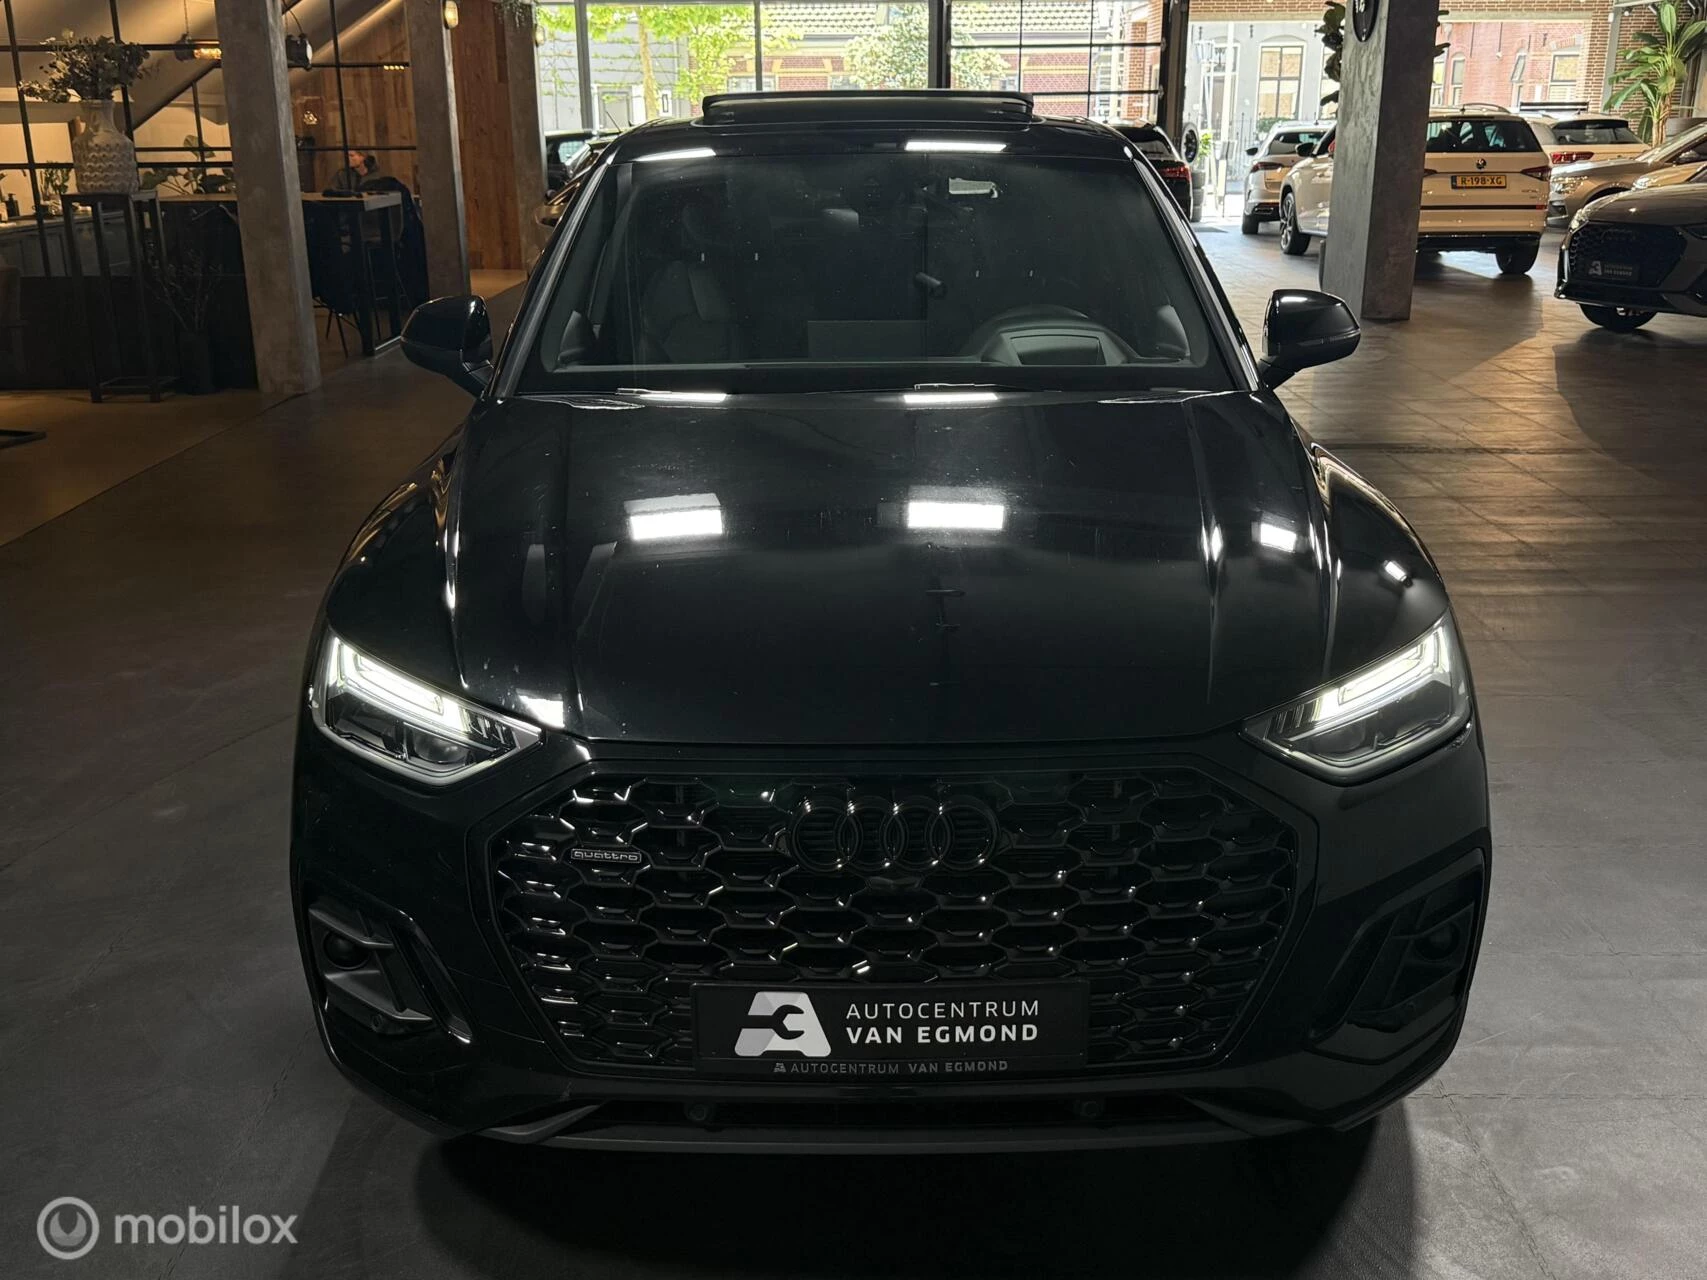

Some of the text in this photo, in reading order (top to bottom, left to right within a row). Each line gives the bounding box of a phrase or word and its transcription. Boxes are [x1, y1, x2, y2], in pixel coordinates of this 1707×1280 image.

[574, 851, 638, 861] quattro
[846, 1000, 1039, 1020] AUTOCENTRUM
[846, 1024, 1038, 1044] VAN EGMOND
[790, 1060, 1008, 1074] AUTOCENTRUM VAN EGMOND
